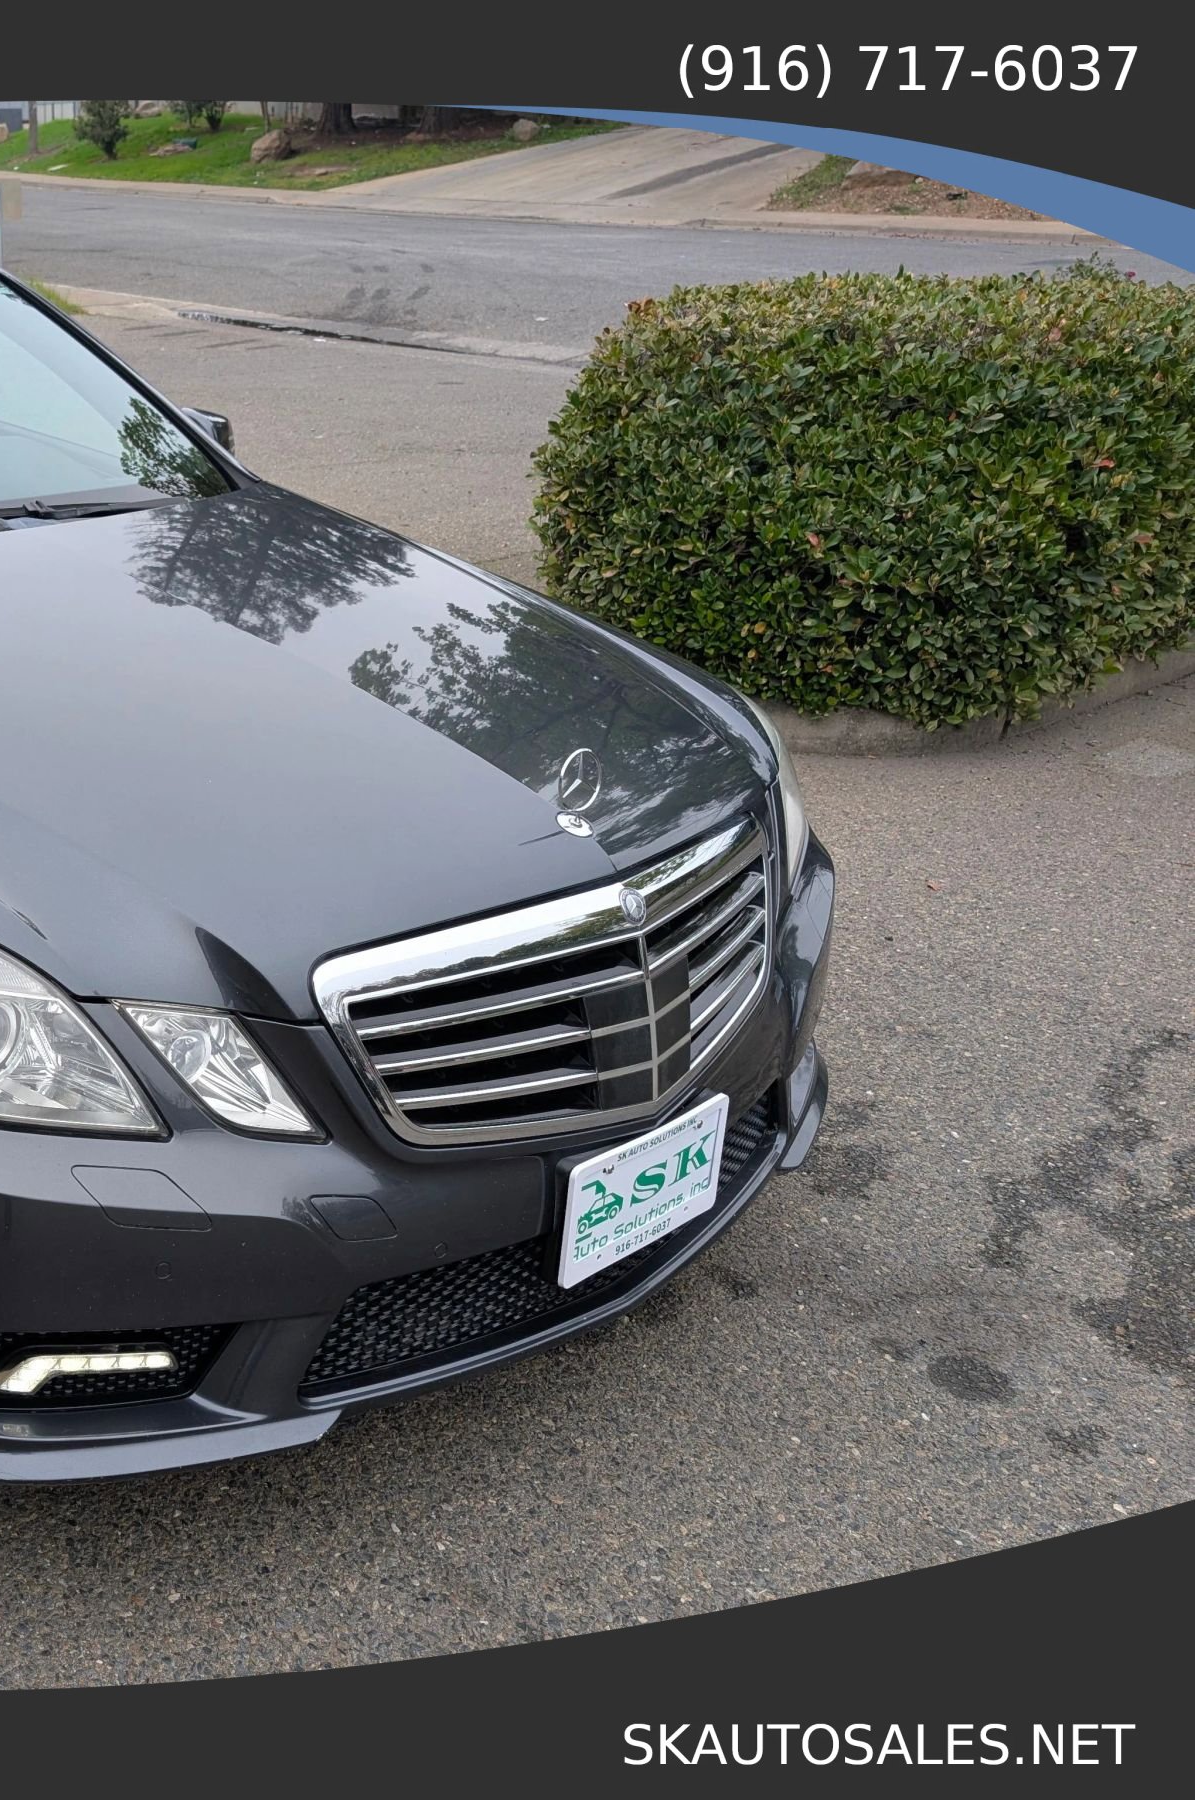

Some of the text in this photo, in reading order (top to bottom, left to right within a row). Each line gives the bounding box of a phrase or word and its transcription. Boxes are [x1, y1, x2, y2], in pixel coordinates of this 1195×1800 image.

[617, 1150, 628, 1161] SK
[628, 1142, 649, 1156] AUTO
[649, 1122, 687, 1148] SOLUTIONS
[629, 1130, 716, 1208] SK
[615, 1217, 672, 1256] 916-717-6037
